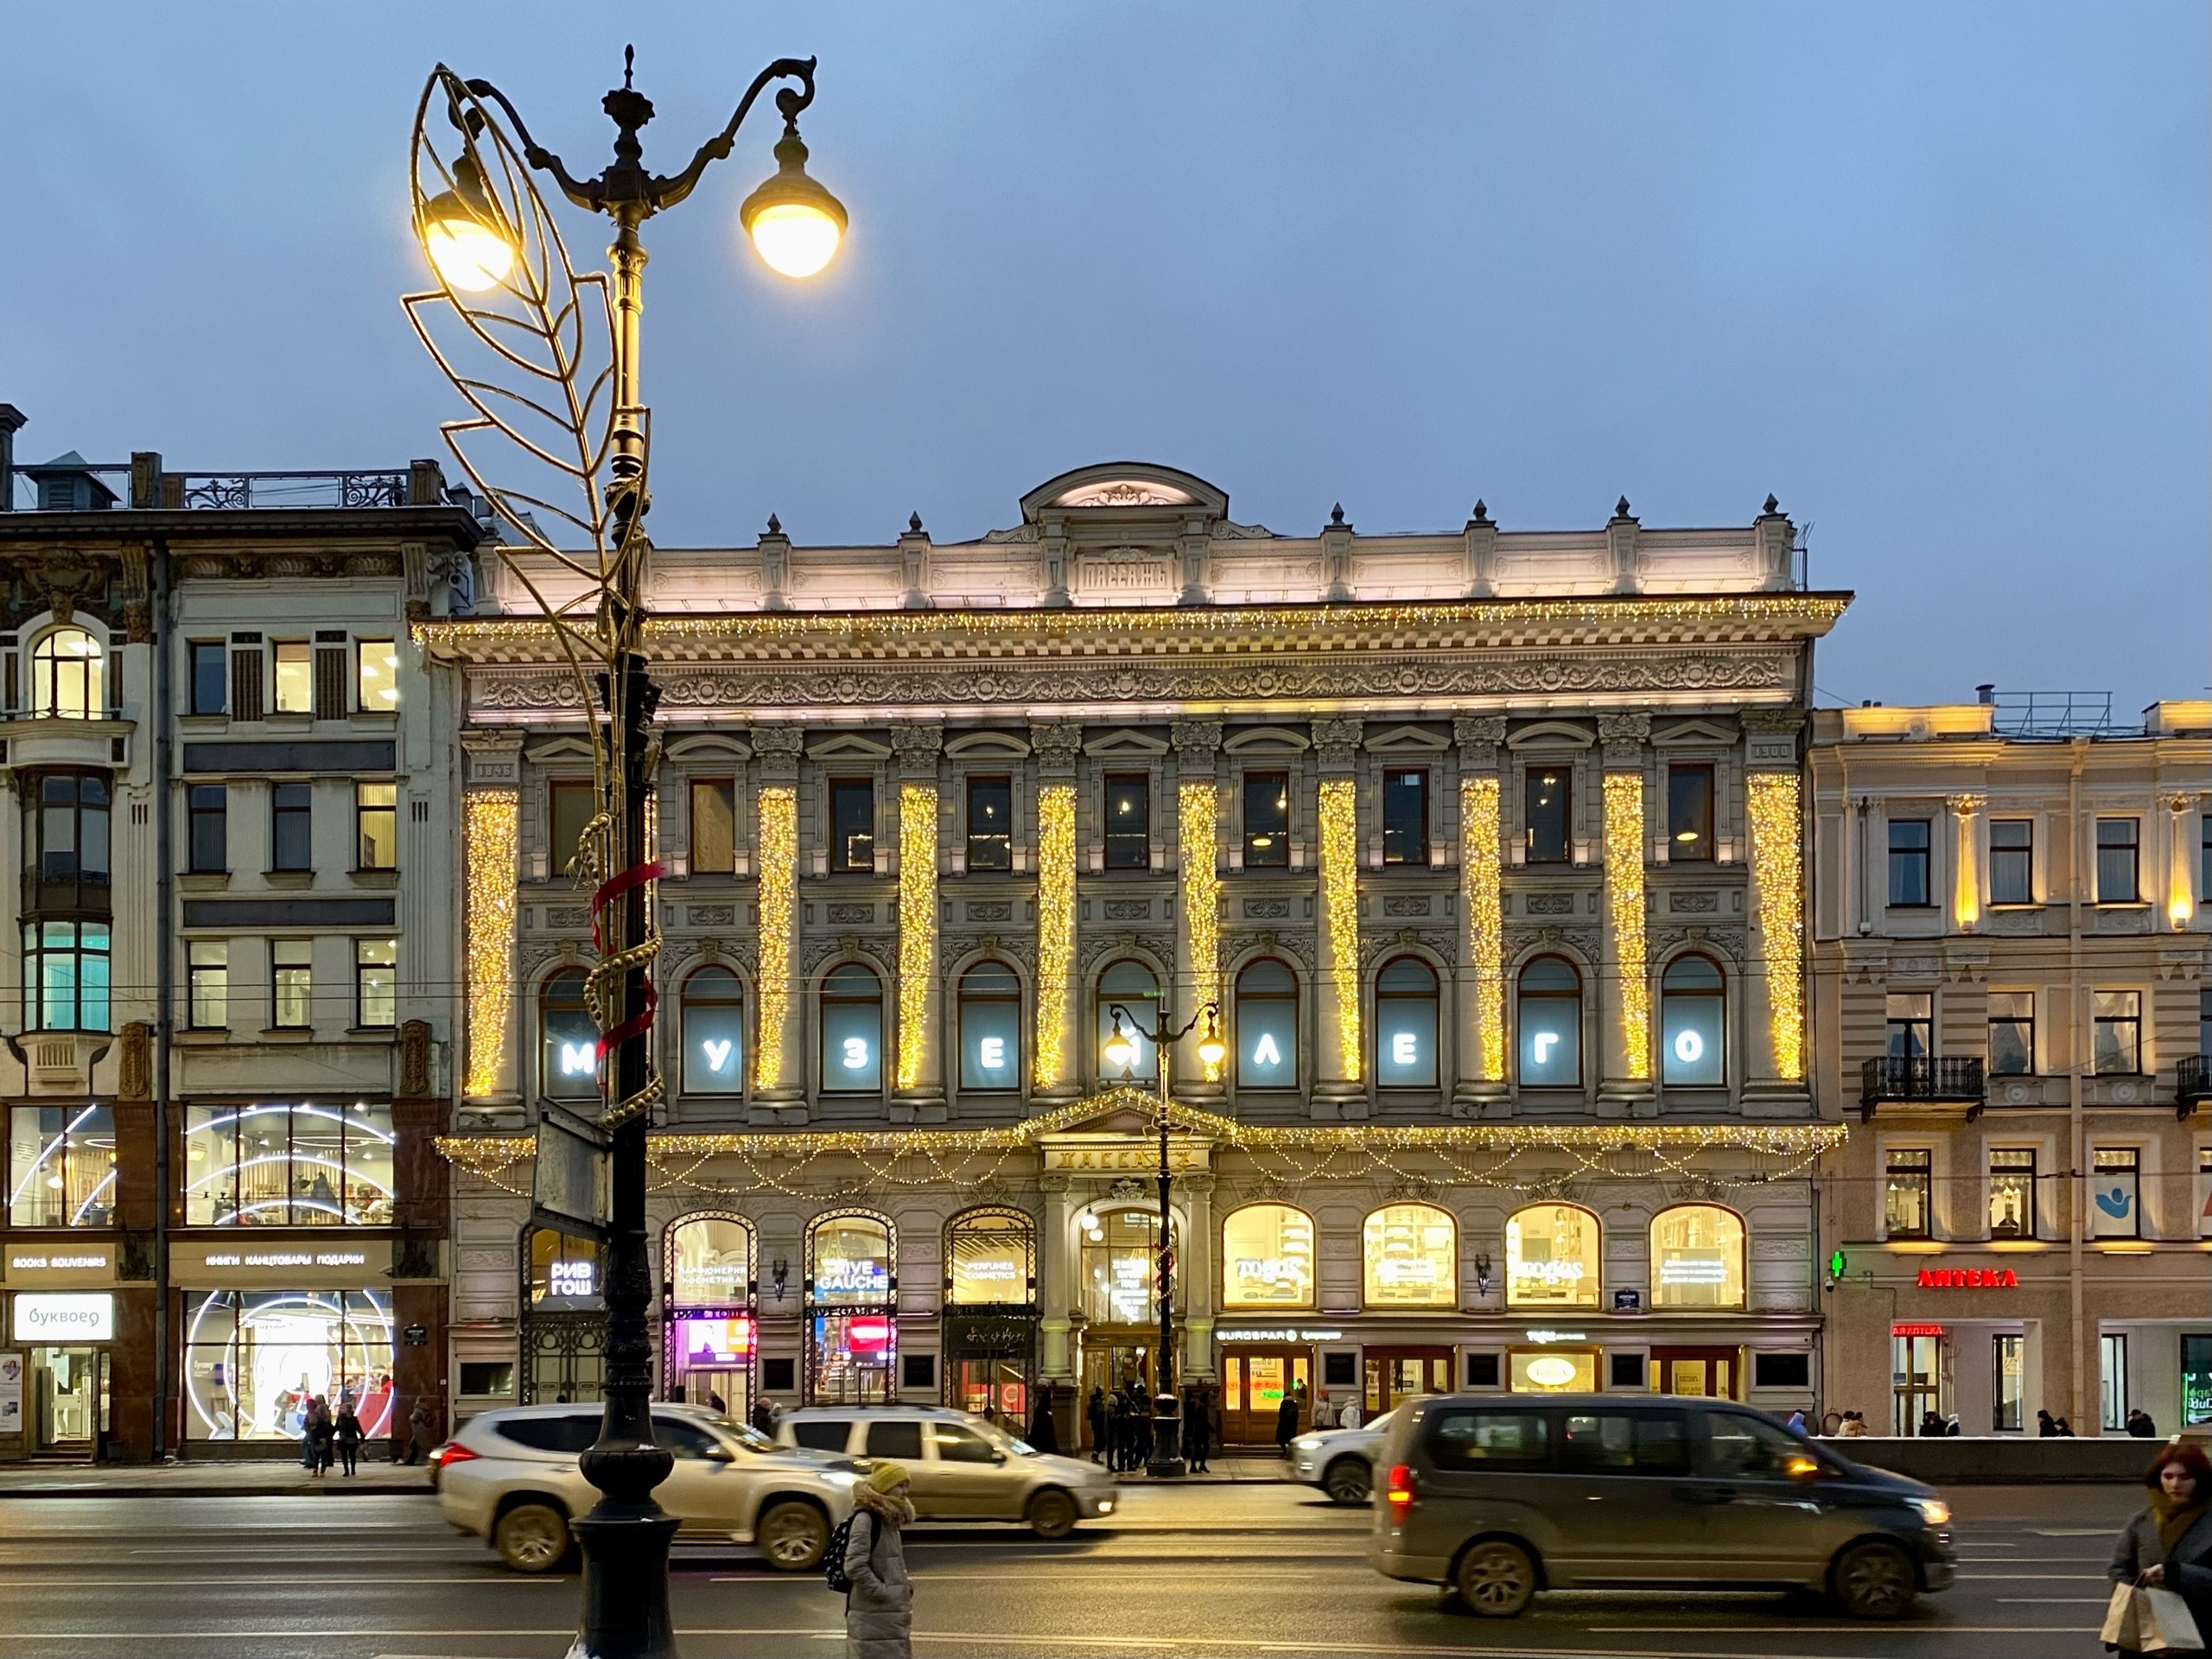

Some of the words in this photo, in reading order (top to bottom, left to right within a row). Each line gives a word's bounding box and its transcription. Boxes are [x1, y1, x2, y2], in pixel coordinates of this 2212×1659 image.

[1754, 746, 1788, 758] 1900
[478, 765, 511, 777] 1846
[13, 1257, 47, 1268] BOOKS
[51, 1256, 106, 1268] SOUVENIRS
[206, 1255, 240, 1266] КНИГИ
[245, 1255, 312, 1267] КАНЦТОВАРЫ
[316, 1255, 364, 1266] ПОДАРКИ
[968, 1262, 1014, 1271] PERFUMES
[551, 1262, 592, 1279] РИВ
[678, 1266, 747, 1275] ПАРФЮМЕРИЯ
[824, 1261, 874, 1275] RIVE
[683, 1276, 743, 1285] КОСМЕТИКА
[818, 1274, 888, 1290] GAUCHE
[1917, 1268, 2020, 1287] АПТЕКА
[551, 1280, 592, 1296] ГОШ
[29, 1307, 99, 1327] буквоед
